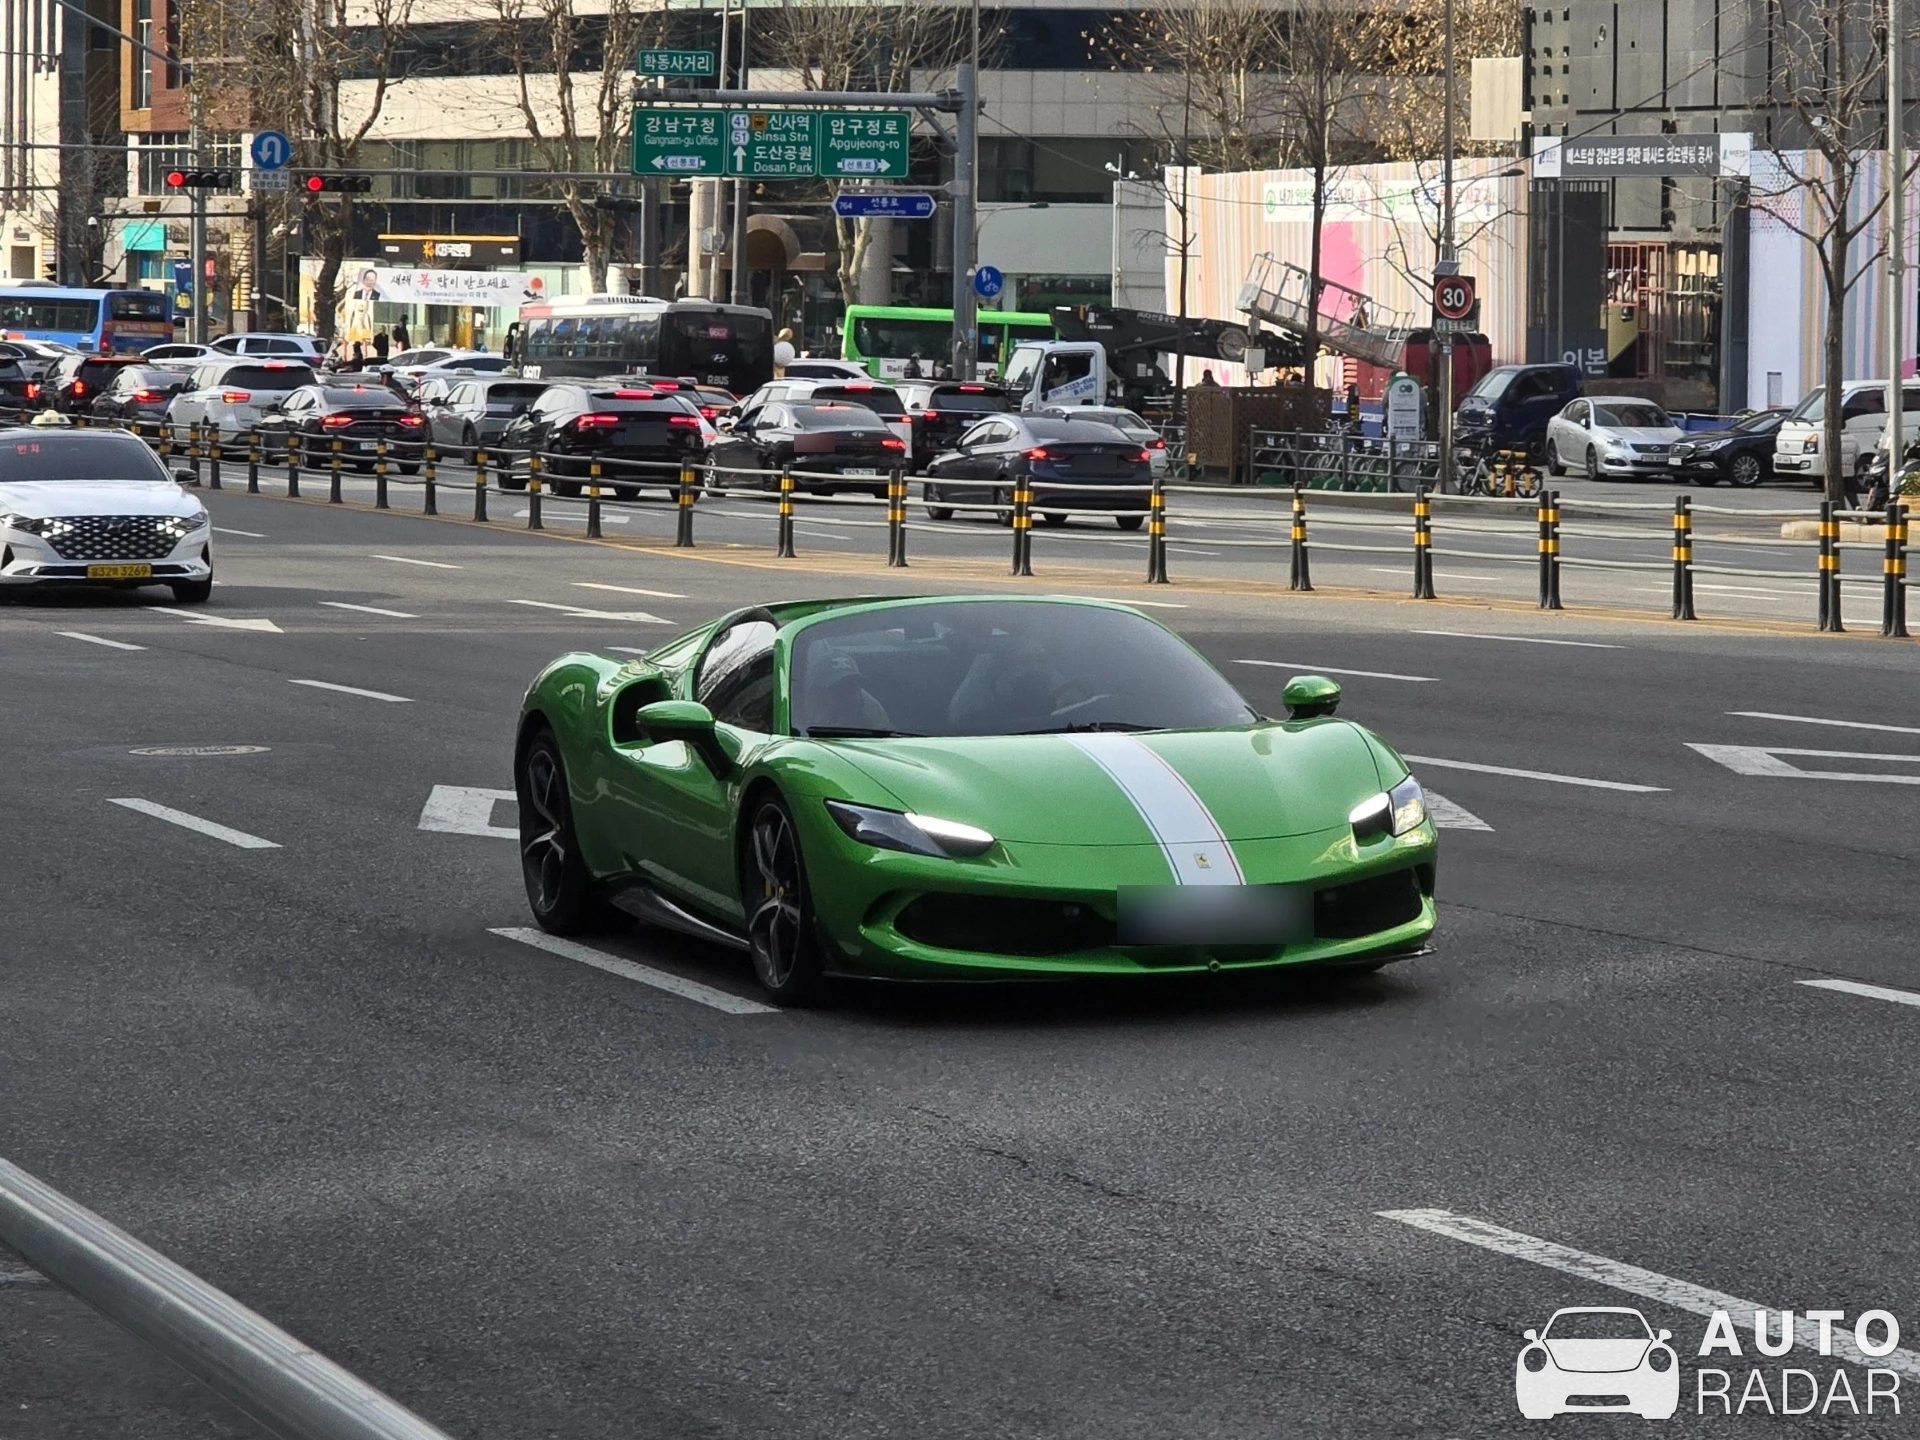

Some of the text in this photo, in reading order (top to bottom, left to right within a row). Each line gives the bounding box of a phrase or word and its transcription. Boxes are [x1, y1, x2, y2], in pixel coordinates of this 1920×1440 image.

[644, 53, 710, 72] 학동사거리
[646, 116, 715, 134] 강남구청
[733, 116, 748, 128] 41
[768, 115, 811, 131] 신사역
[830, 119, 899, 135] 압구정로
[644, 134, 719, 147] Gangnam-gu Office
[733, 132, 748, 144] 51
[754, 131, 809, 142] Sinsa Stn
[829, 138, 900, 151] Apgujeong-ro
[754, 145, 812, 161] 도산공원
[1566, 147, 1595, 165] 베스트샵
[1596, 147, 1625, 165] 강남본점
[1626, 147, 1641, 165] 외관
[1642, 147, 1665, 164] 파사드
[1698, 145, 1713, 164] 공사
[754, 162, 813, 173] Dosan Park
[846, 159, 873, 170] 선릉로
[839, 202, 853, 210] 764
[870, 197, 899, 208] 선릉로
[916, 202, 930, 211] 802
[418, 273, 432, 288] 복
[437, 274, 459, 289] 많이
[464, 275, 510, 290] 받으세요
[1442, 287, 1465, 307] 30
[120, 565, 148, 577] 3269
